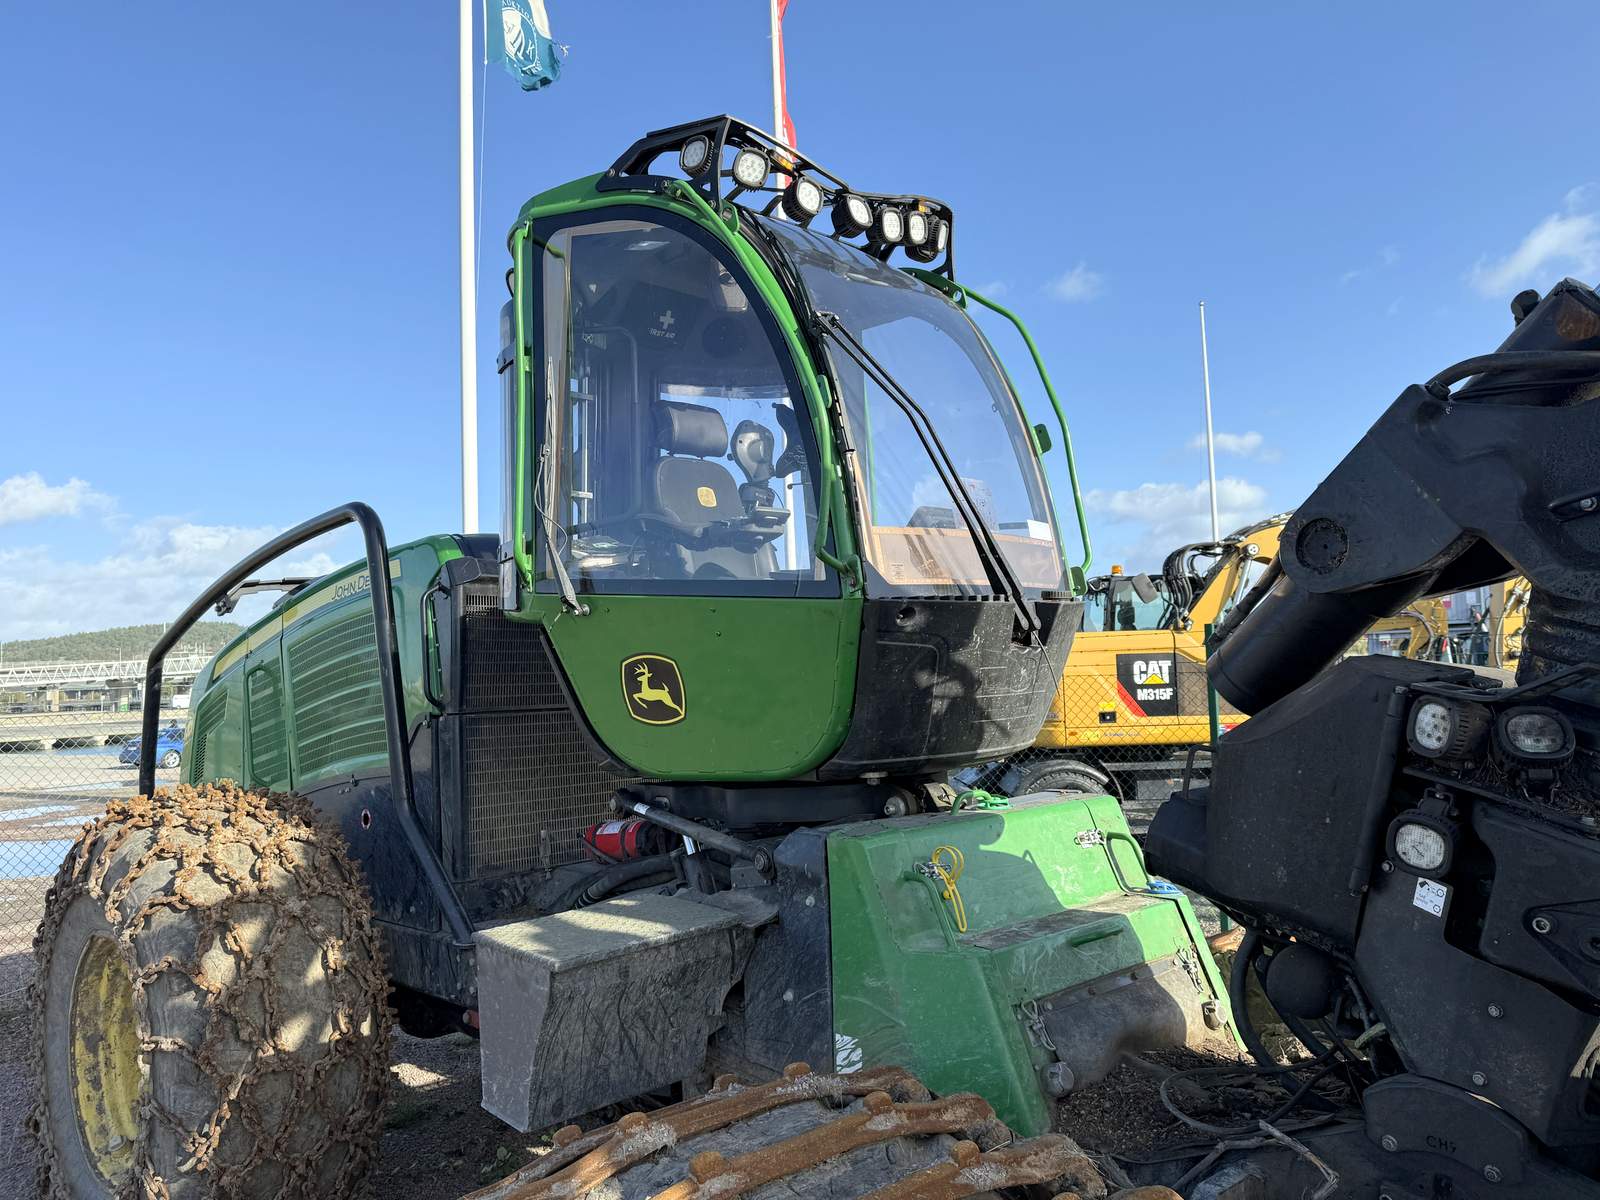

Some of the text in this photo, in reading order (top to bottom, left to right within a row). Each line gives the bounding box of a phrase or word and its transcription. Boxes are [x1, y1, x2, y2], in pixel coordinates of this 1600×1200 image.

[331, 580, 357, 600] JOHN
[1133, 660, 1172, 685] CAT
[1136, 688, 1174, 701] M315F
